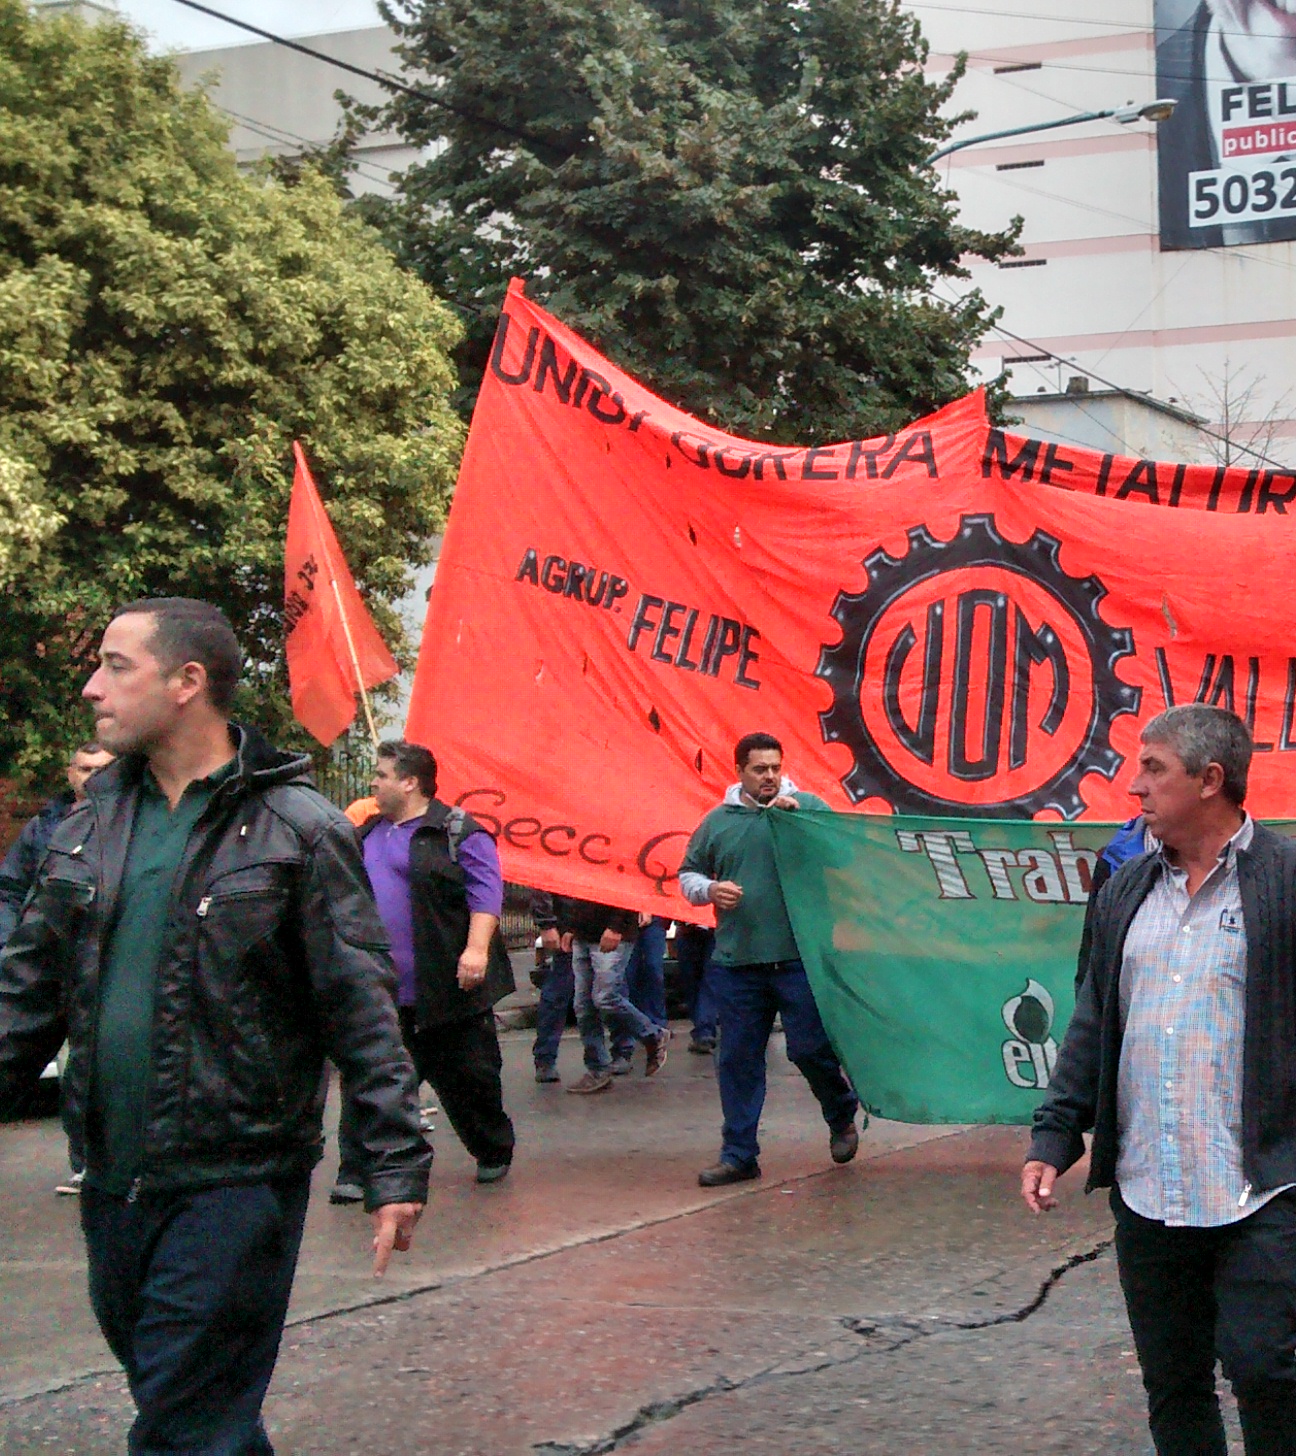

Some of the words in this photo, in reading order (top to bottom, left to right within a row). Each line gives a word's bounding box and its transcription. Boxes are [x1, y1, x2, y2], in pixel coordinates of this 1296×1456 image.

[515, 548, 629, 613] AGRUP.
[627, 593, 762, 690] FELIPE
[883, 588, 1070, 782] UOM
[637, 831, 692, 897] Q
